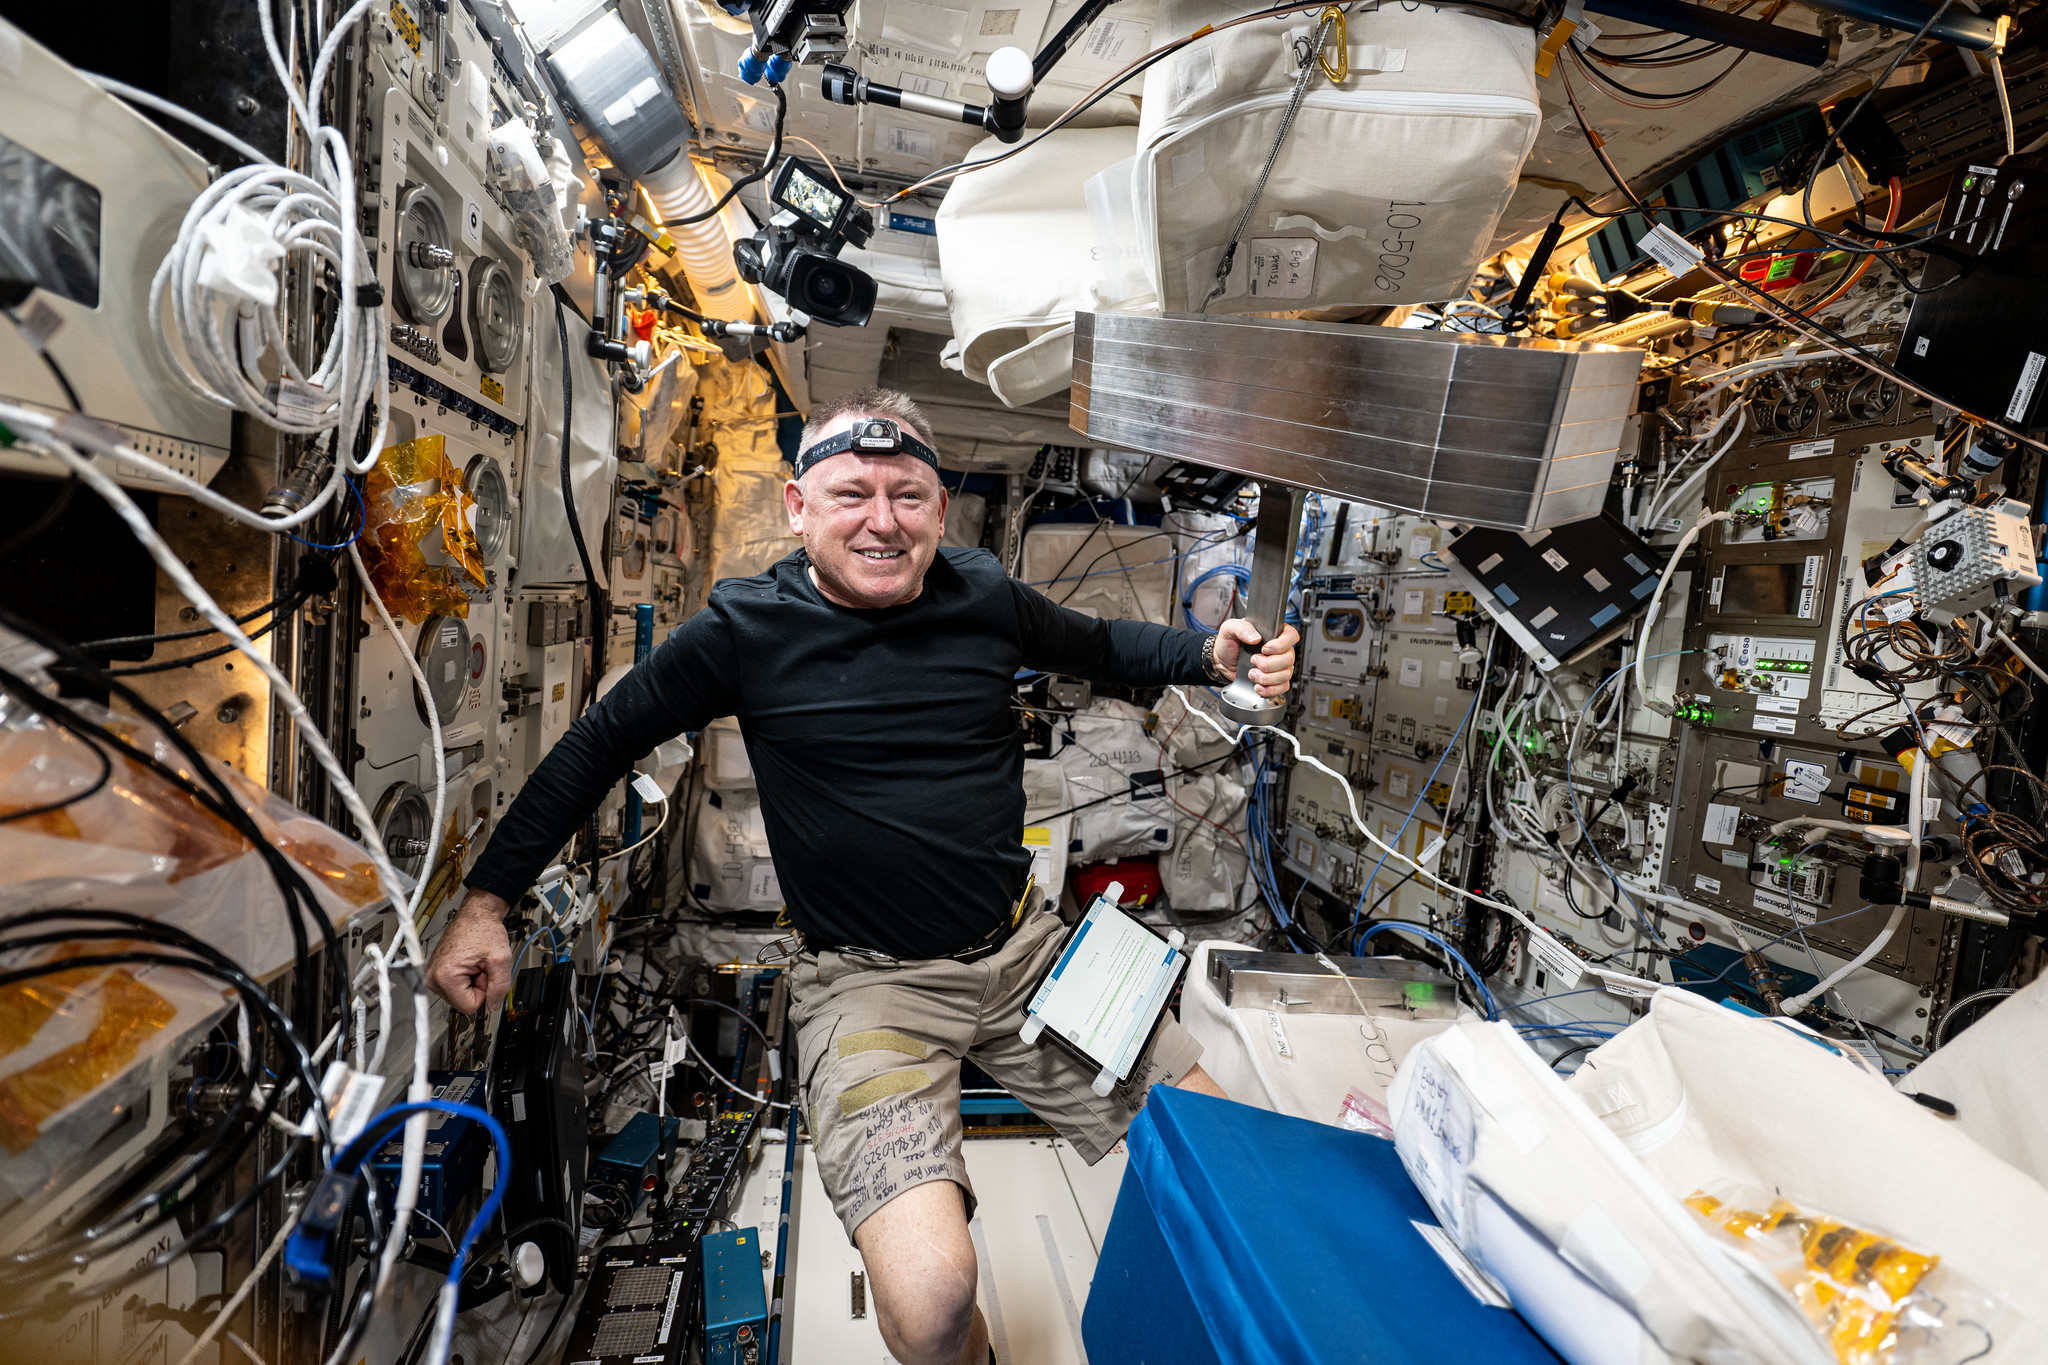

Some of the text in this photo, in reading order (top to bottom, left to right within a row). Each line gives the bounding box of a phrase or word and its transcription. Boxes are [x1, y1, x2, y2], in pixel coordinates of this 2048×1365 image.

[1374, 200, 1427, 292] 1.0-5006
[1590, 327, 1625, 344] EUROPEAN
[1625, 315, 1669, 334] PHYSIOLOGY
[2033, 356, 2045, 381] Lumina
[2021, 379, 2037, 410] Dosimeter
[1807, 558, 1815, 578] SINTEF
[1803, 589, 1813, 610] OHB
[1834, 647, 1842, 664] NASA
[1841, 578, 1852, 614] CONTAINER
[1848, 806, 1870, 822] rise
[1740, 922, 1761, 937] SYSTEM
[1785, 937, 1806, 953] PANEL
[672, 1276, 680, 1291] SUPPLY
[669, 1291, 677, 1306] POWER
[663, 1306, 673, 1329] PORTABLE
